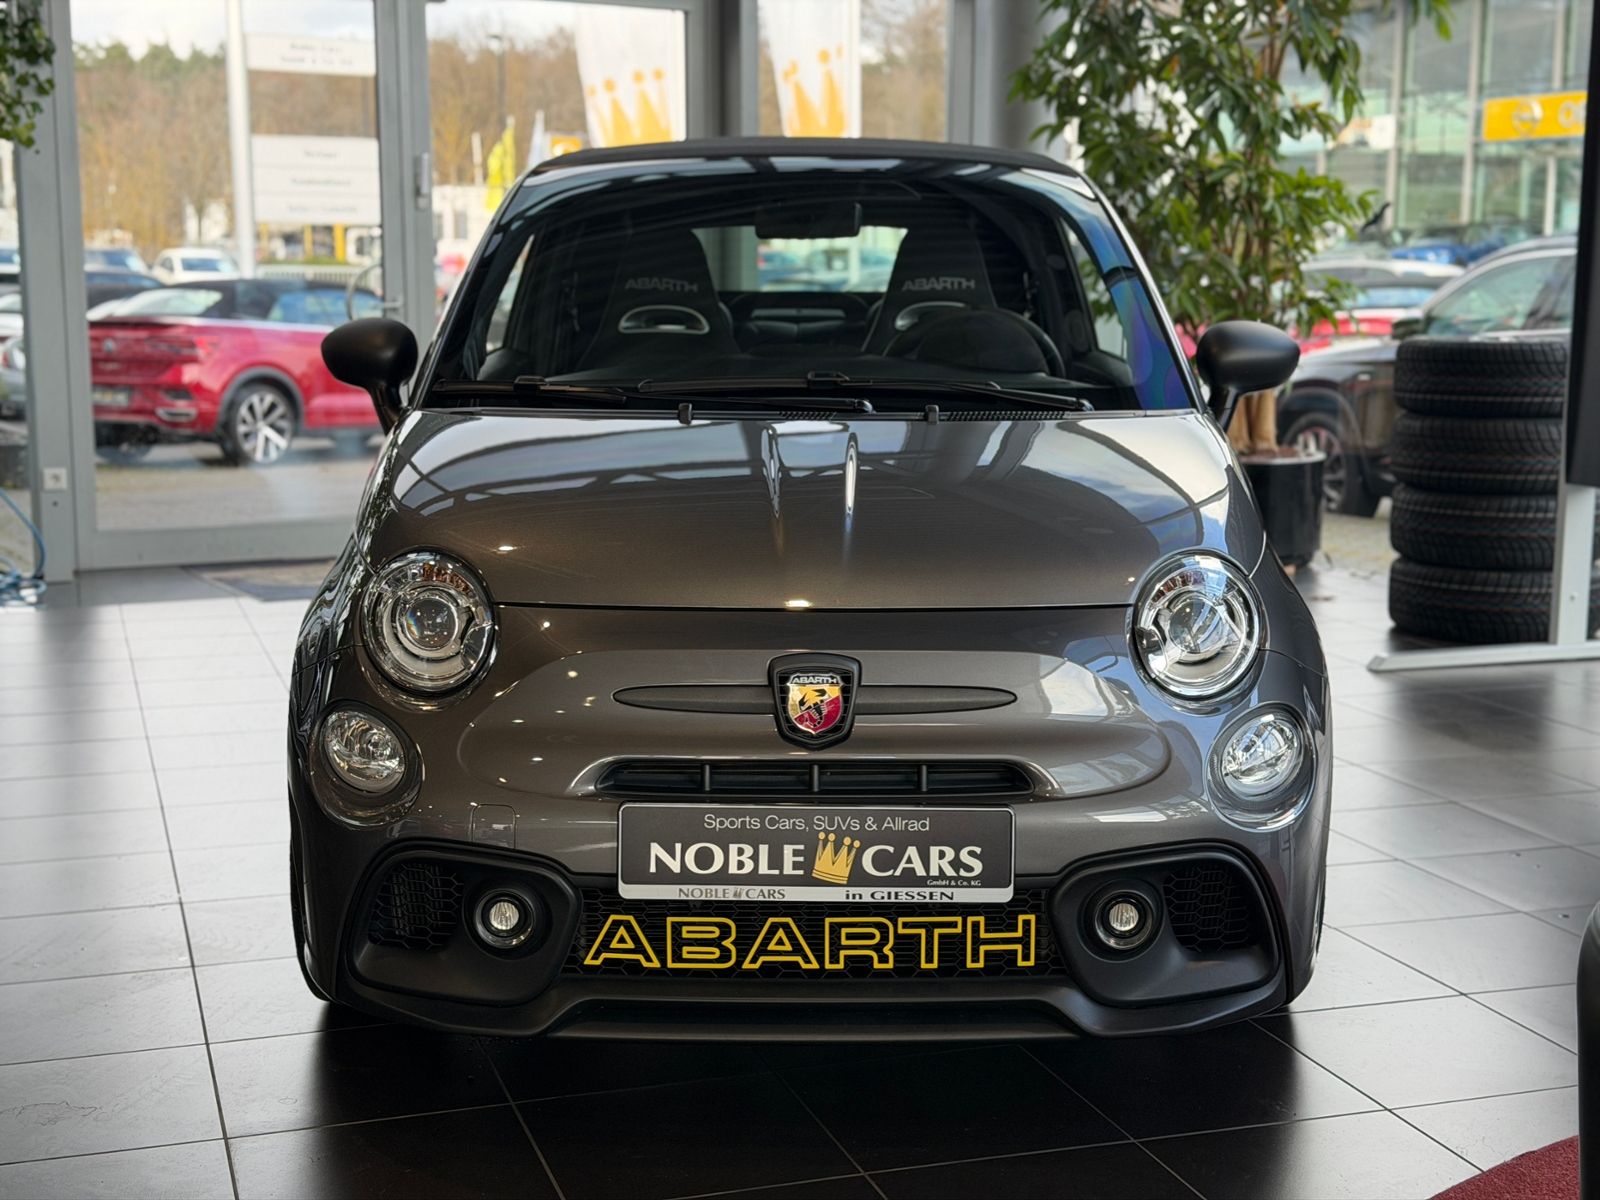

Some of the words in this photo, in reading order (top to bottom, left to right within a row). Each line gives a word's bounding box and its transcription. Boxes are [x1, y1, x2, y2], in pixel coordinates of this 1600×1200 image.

[625, 278, 698, 293] ABARTH
[902, 277, 976, 292] ABARTH
[792, 676, 837, 684] ABARTH
[704, 813, 761, 831] Sports
[764, 815, 809, 831] Cars,
[813, 815, 860, 831] SUVs
[864, 816, 878, 831] &
[881, 816, 930, 832] Allrad
[649, 842, 805, 875] NOBLE
[861, 845, 984, 877] CARS
[927, 879, 949, 887] GmbH
[957, 879, 969, 887] Co.
[970, 879, 982, 887] KG
[678, 888, 730, 900] NOBLE
[745, 888, 786, 900] CARS
[845, 890, 863, 901] in
[870, 891, 954, 901] GIESSEN
[583, 914, 1037, 970] ABARTH
